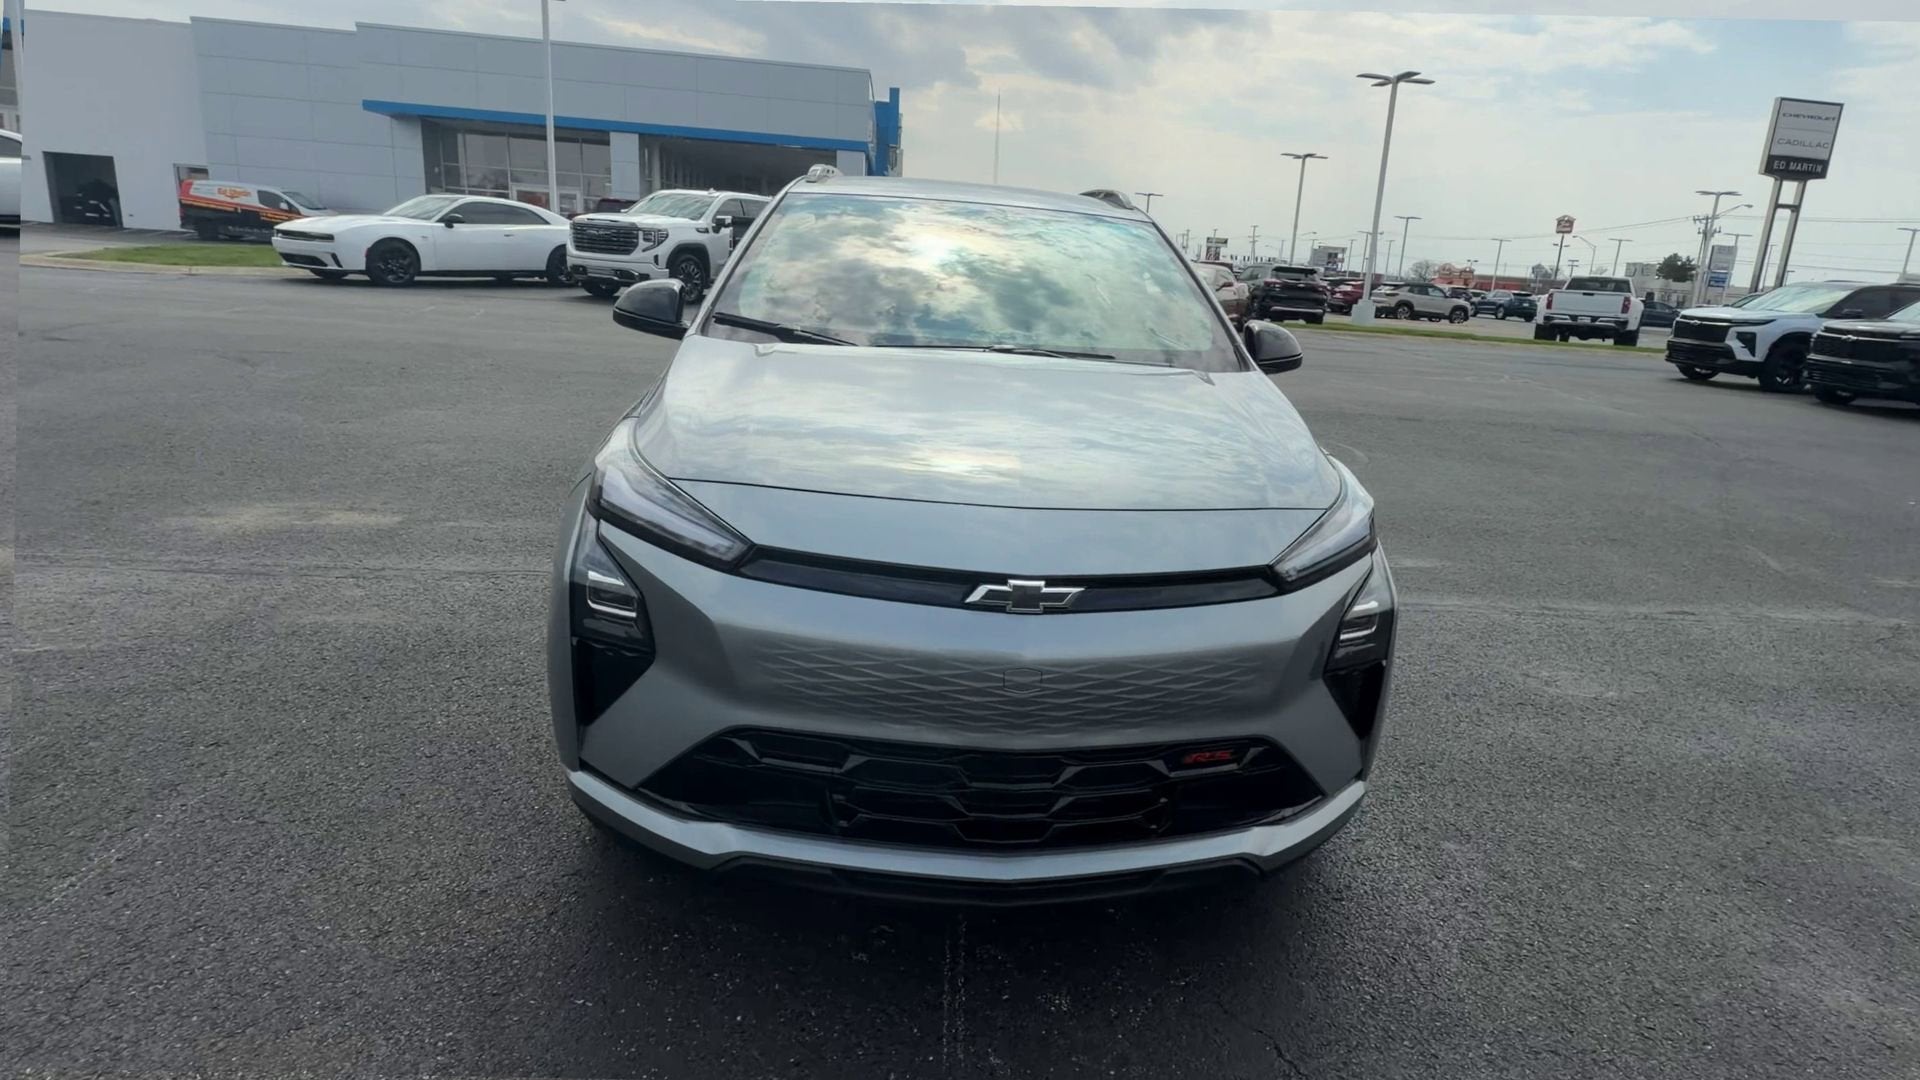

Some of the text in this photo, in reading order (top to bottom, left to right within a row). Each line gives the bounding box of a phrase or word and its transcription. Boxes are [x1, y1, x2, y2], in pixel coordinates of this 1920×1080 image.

[1782, 112, 1836, 121] CHEVROLET
[1777, 138, 1830, 149] CADILLAC
[1773, 160, 1823, 173] ED MARTIN
